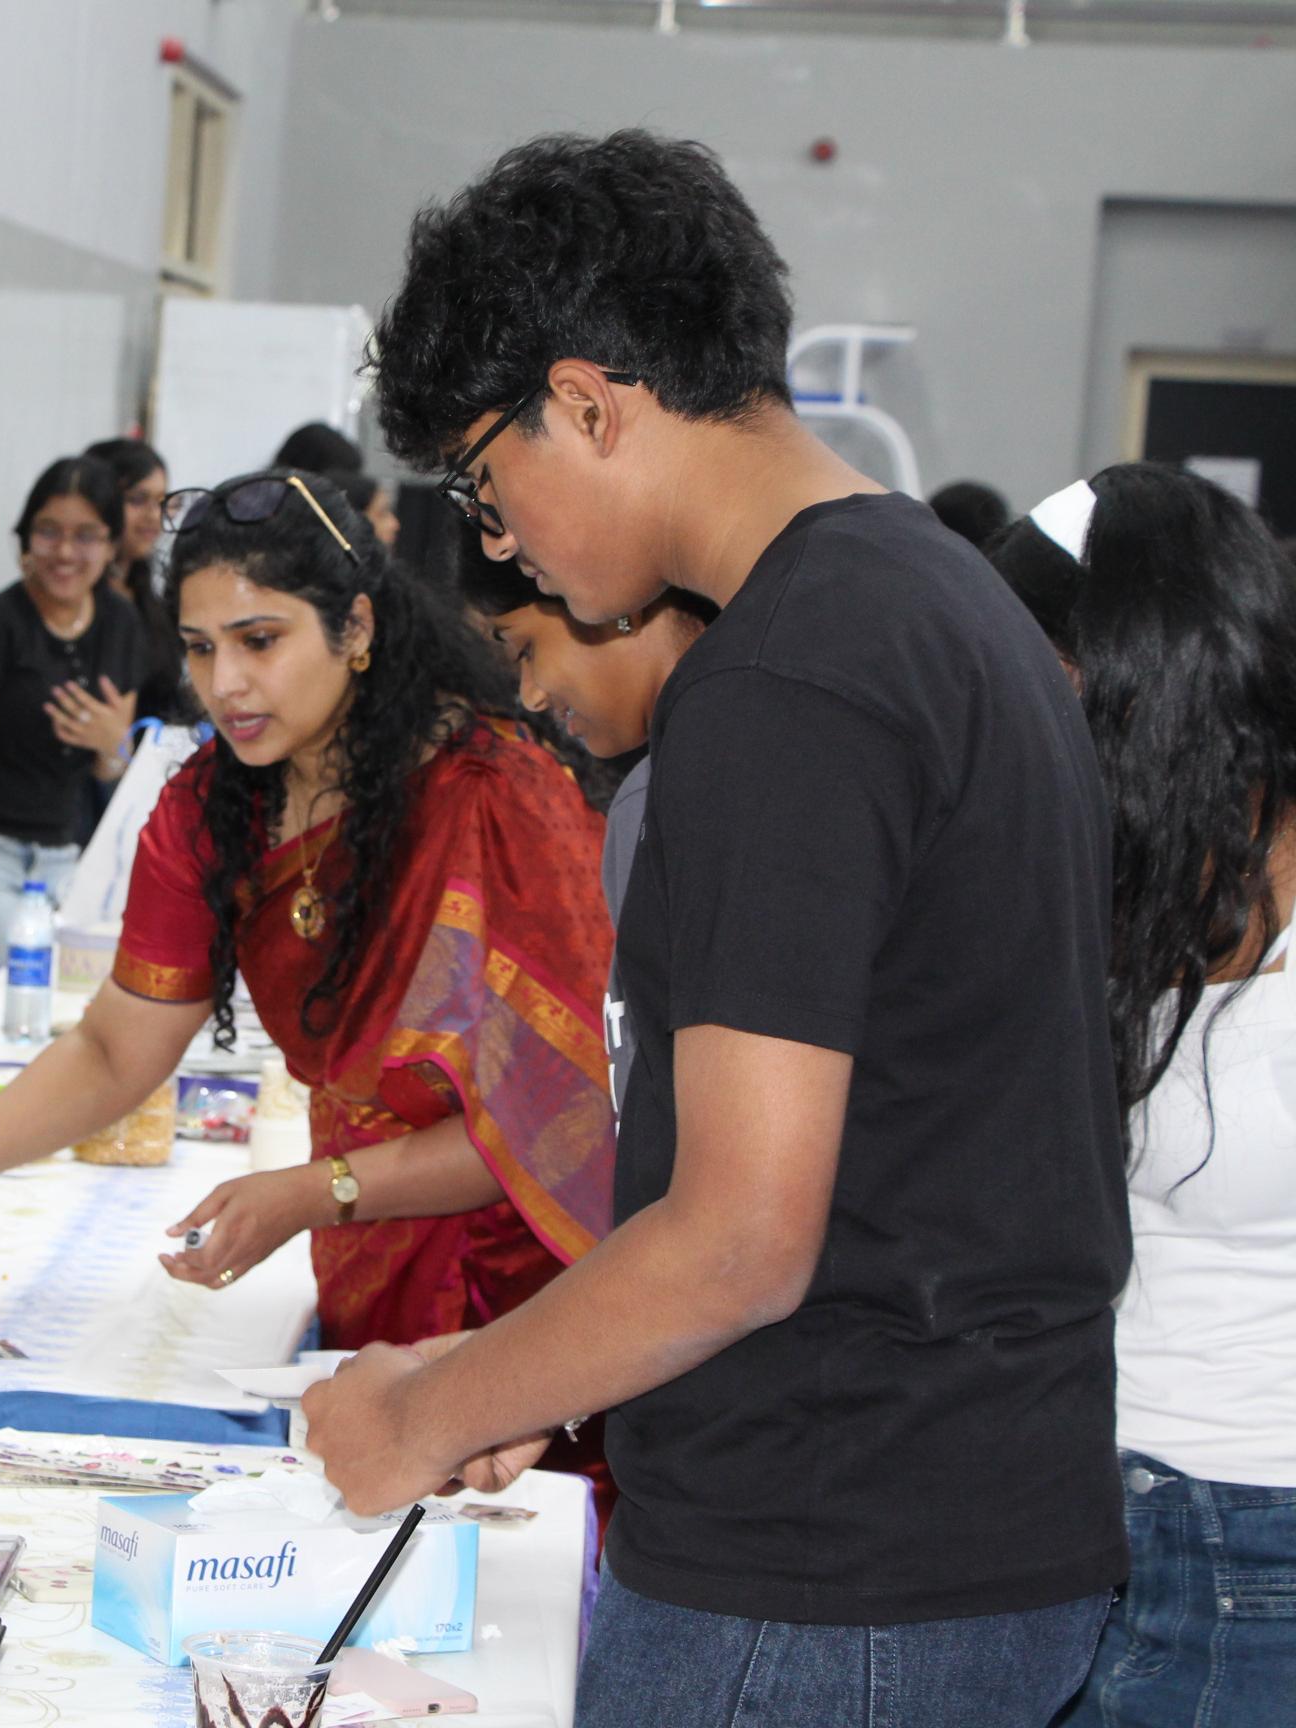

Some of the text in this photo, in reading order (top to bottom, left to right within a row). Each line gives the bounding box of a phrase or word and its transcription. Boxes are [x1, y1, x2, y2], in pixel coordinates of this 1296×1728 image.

[100, 1525, 140, 1563] masafi
[186, 1540, 297, 1588] masafi
[185, 1582, 264, 1592] PURE SOFT CARE
[435, 1622, 463, 1633] 170x2
